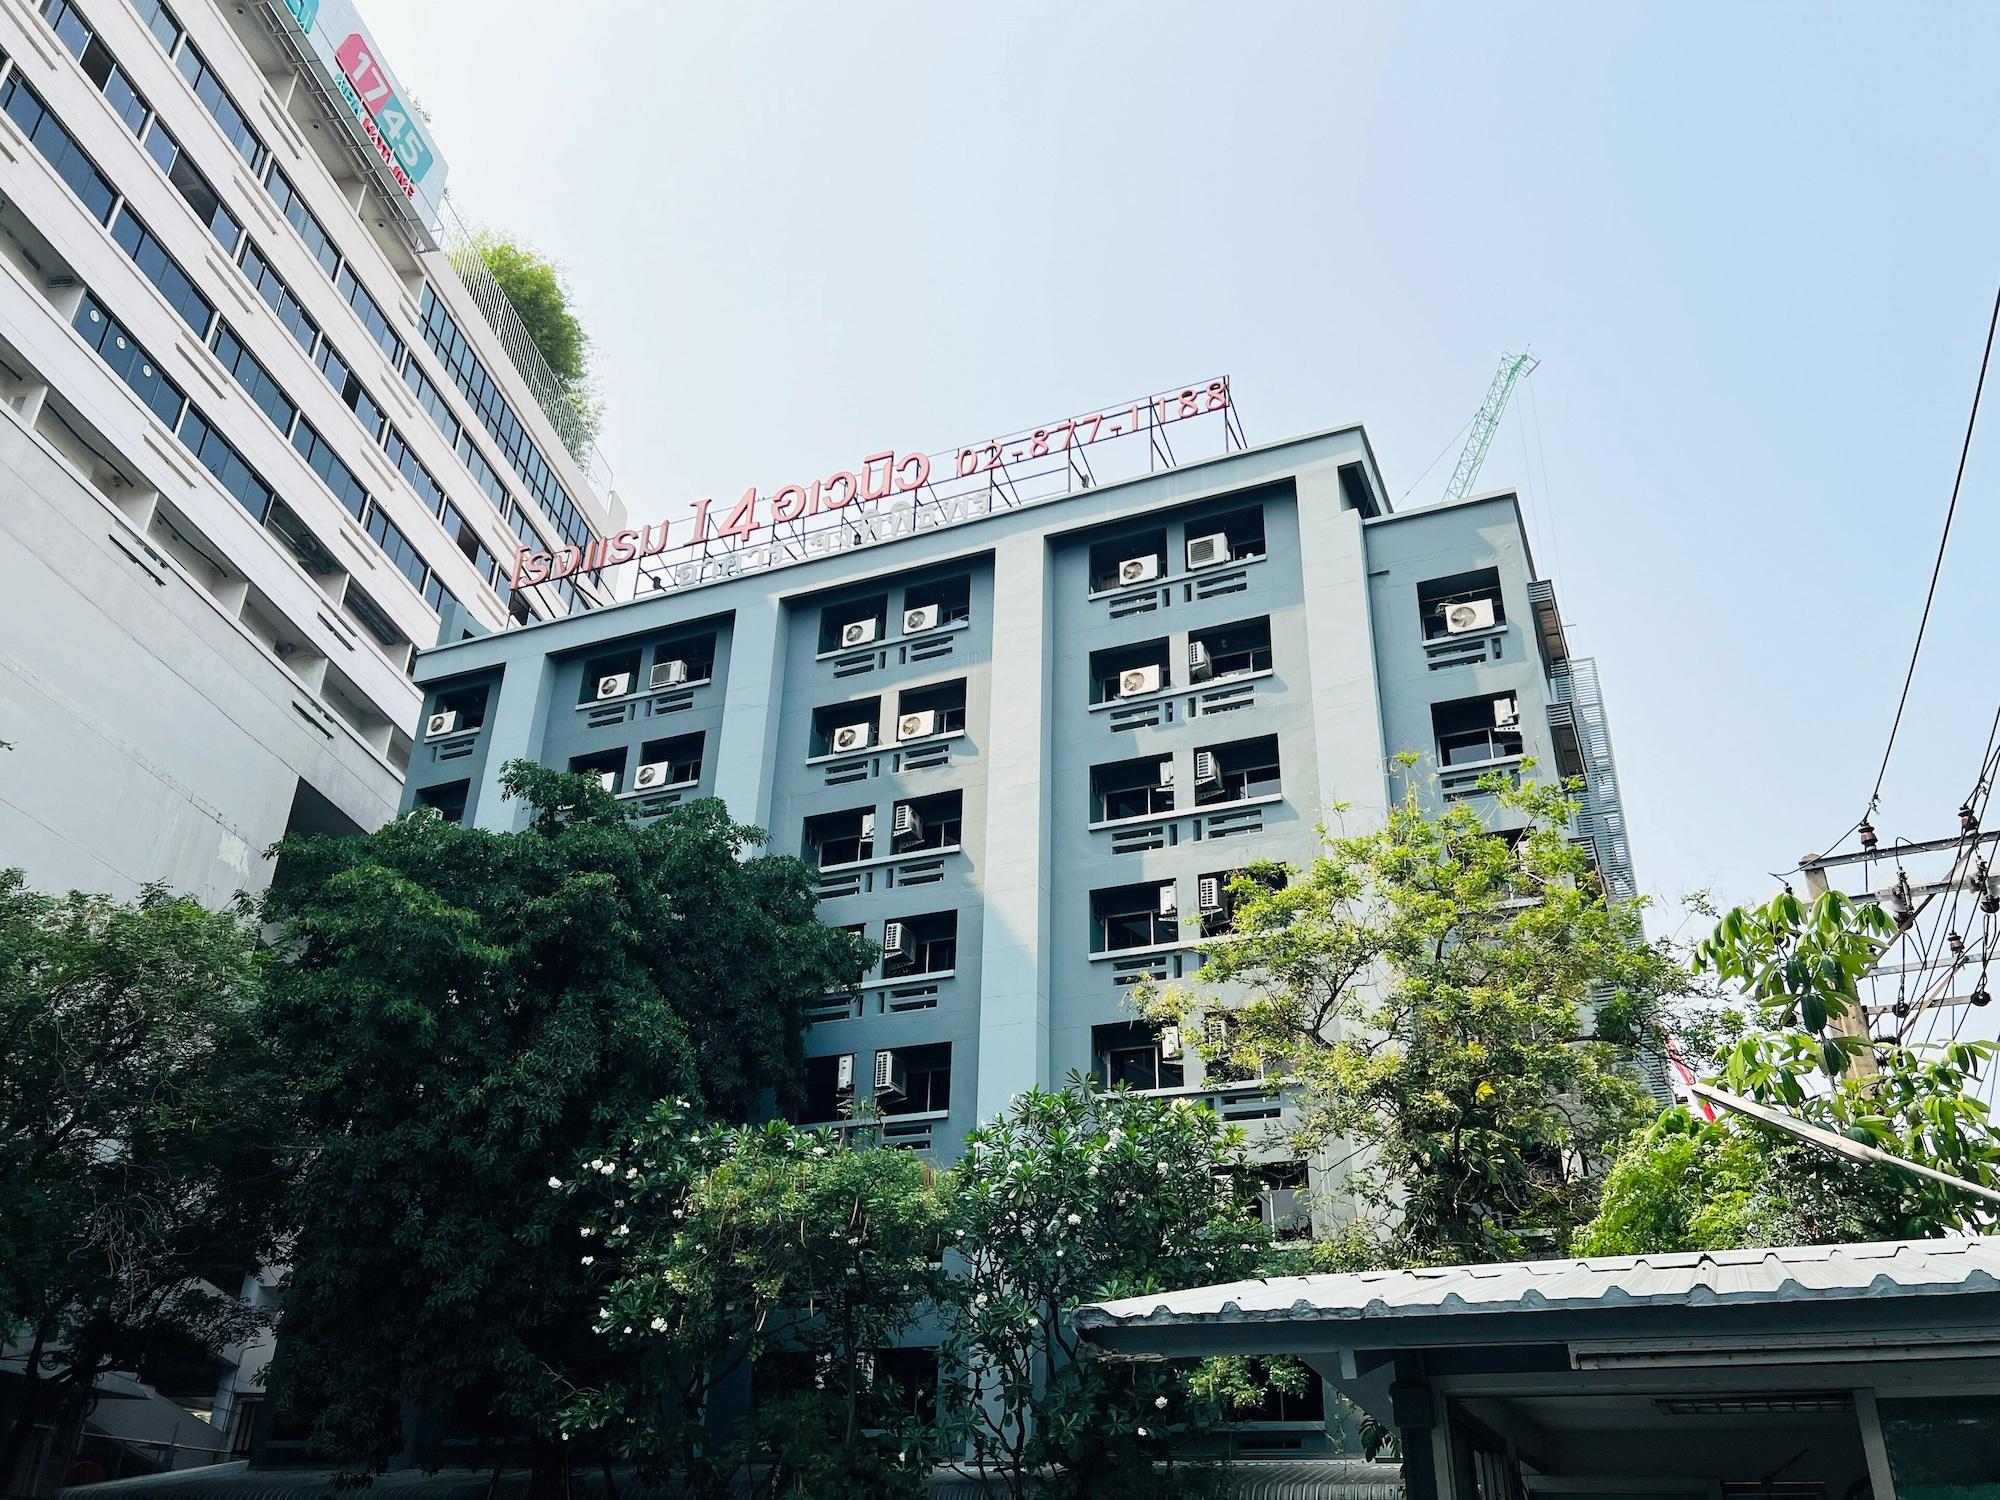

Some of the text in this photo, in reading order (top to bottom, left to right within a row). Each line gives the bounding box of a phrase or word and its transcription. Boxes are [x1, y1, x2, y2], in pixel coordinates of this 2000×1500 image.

[352, 51, 424, 167] 1745
[510, 518, 670, 590] โรงแรม
[683, 486, 760, 547] 14
[957, 381, 1226, 477] 02-877-1188
